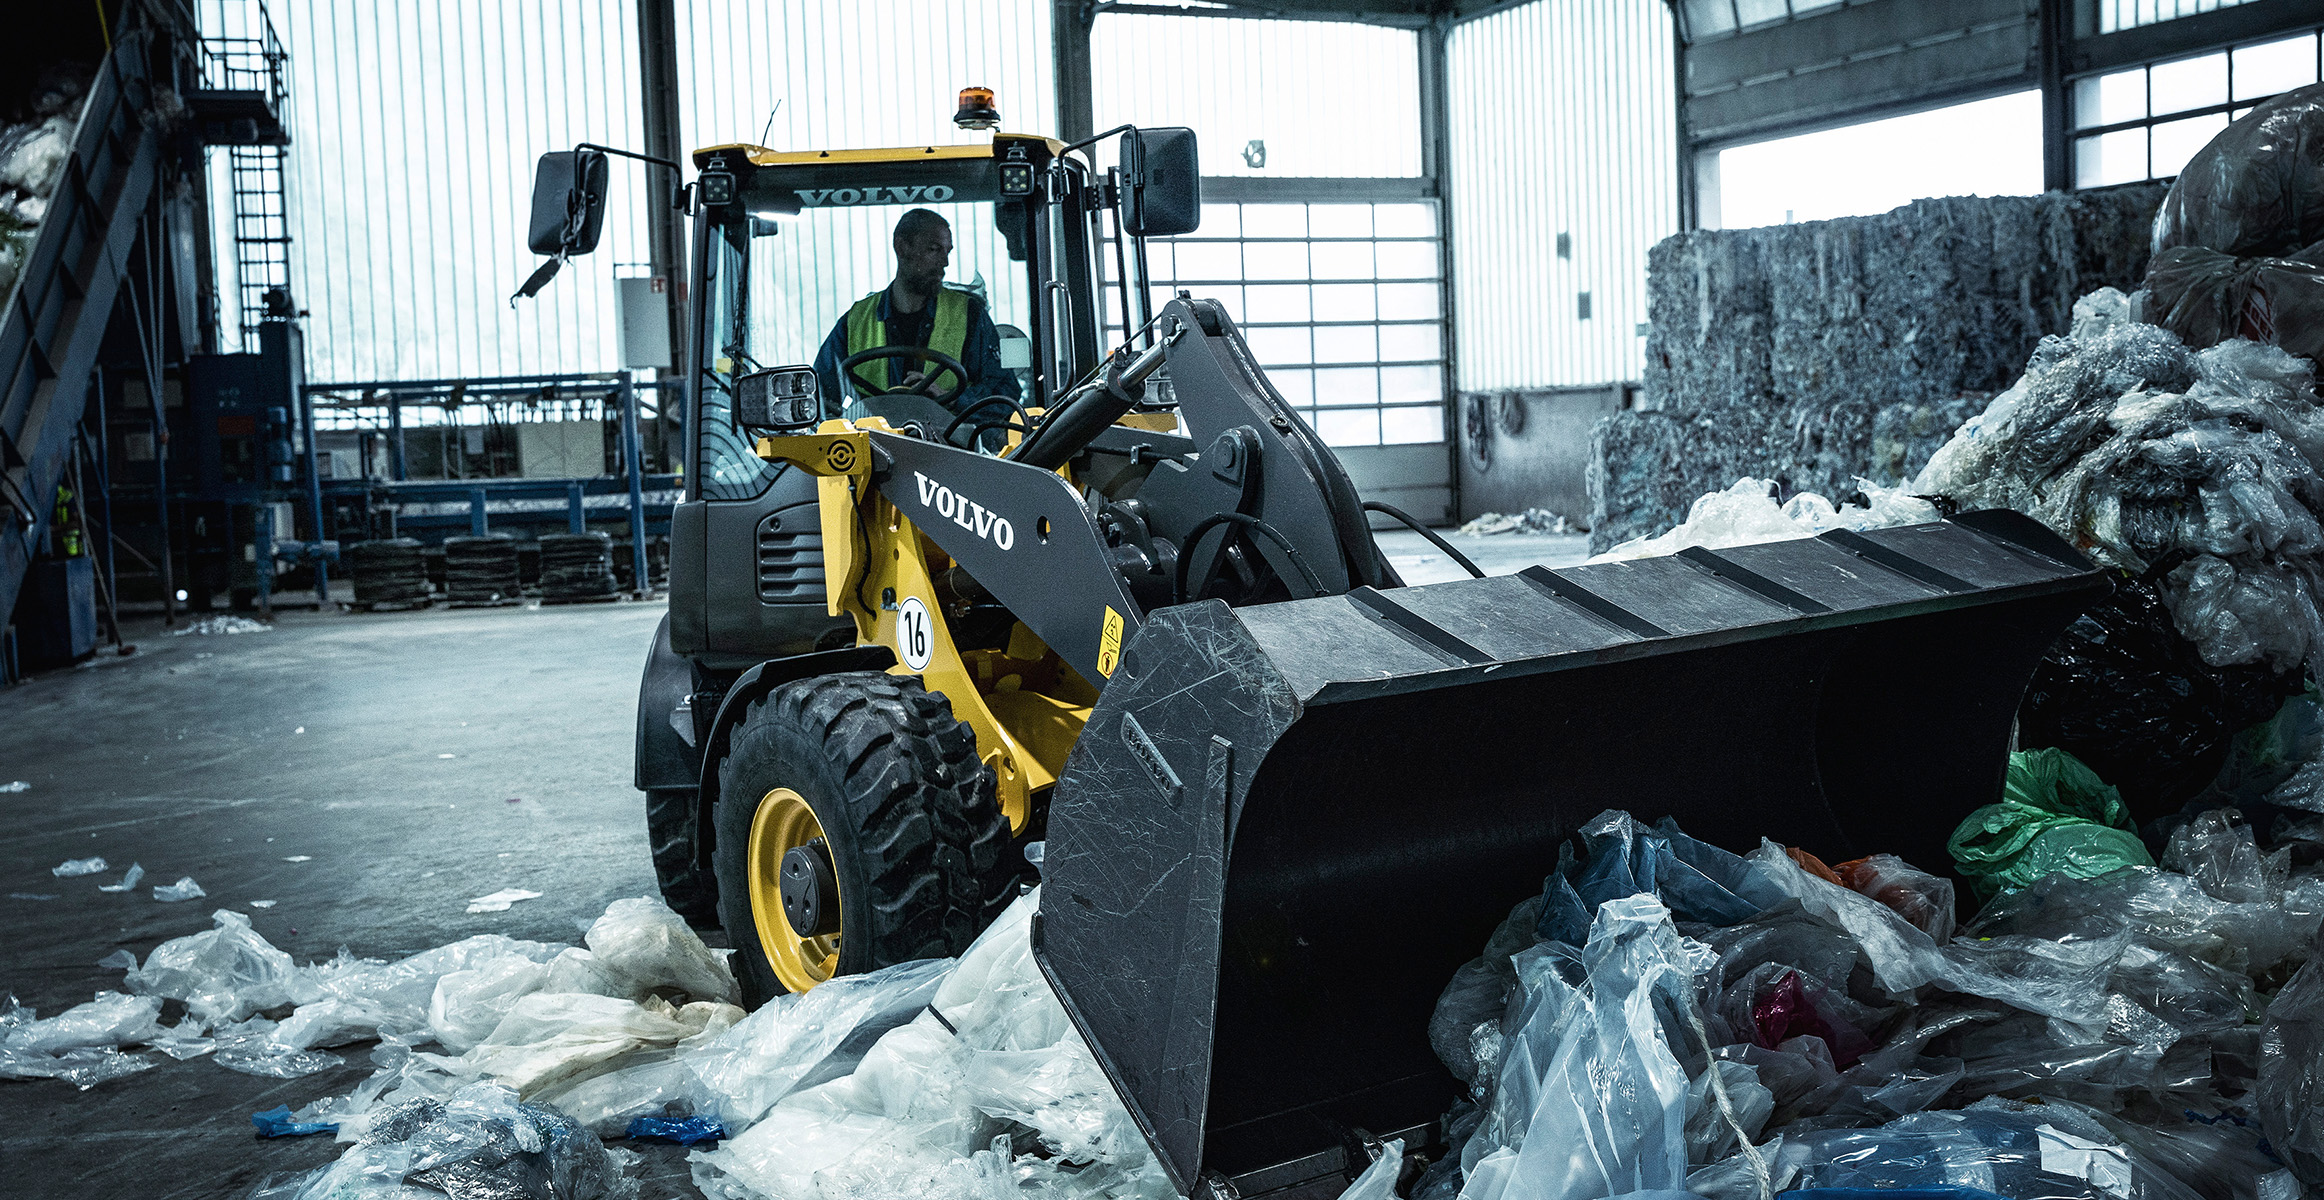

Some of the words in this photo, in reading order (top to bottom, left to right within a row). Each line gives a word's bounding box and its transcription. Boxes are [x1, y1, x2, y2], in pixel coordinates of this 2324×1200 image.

[794, 185, 954, 207] VOLVO
[914, 471, 1014, 551] VOLVO
[905, 611, 925, 657] 16
[1124, 725, 1172, 792] VOLVO
